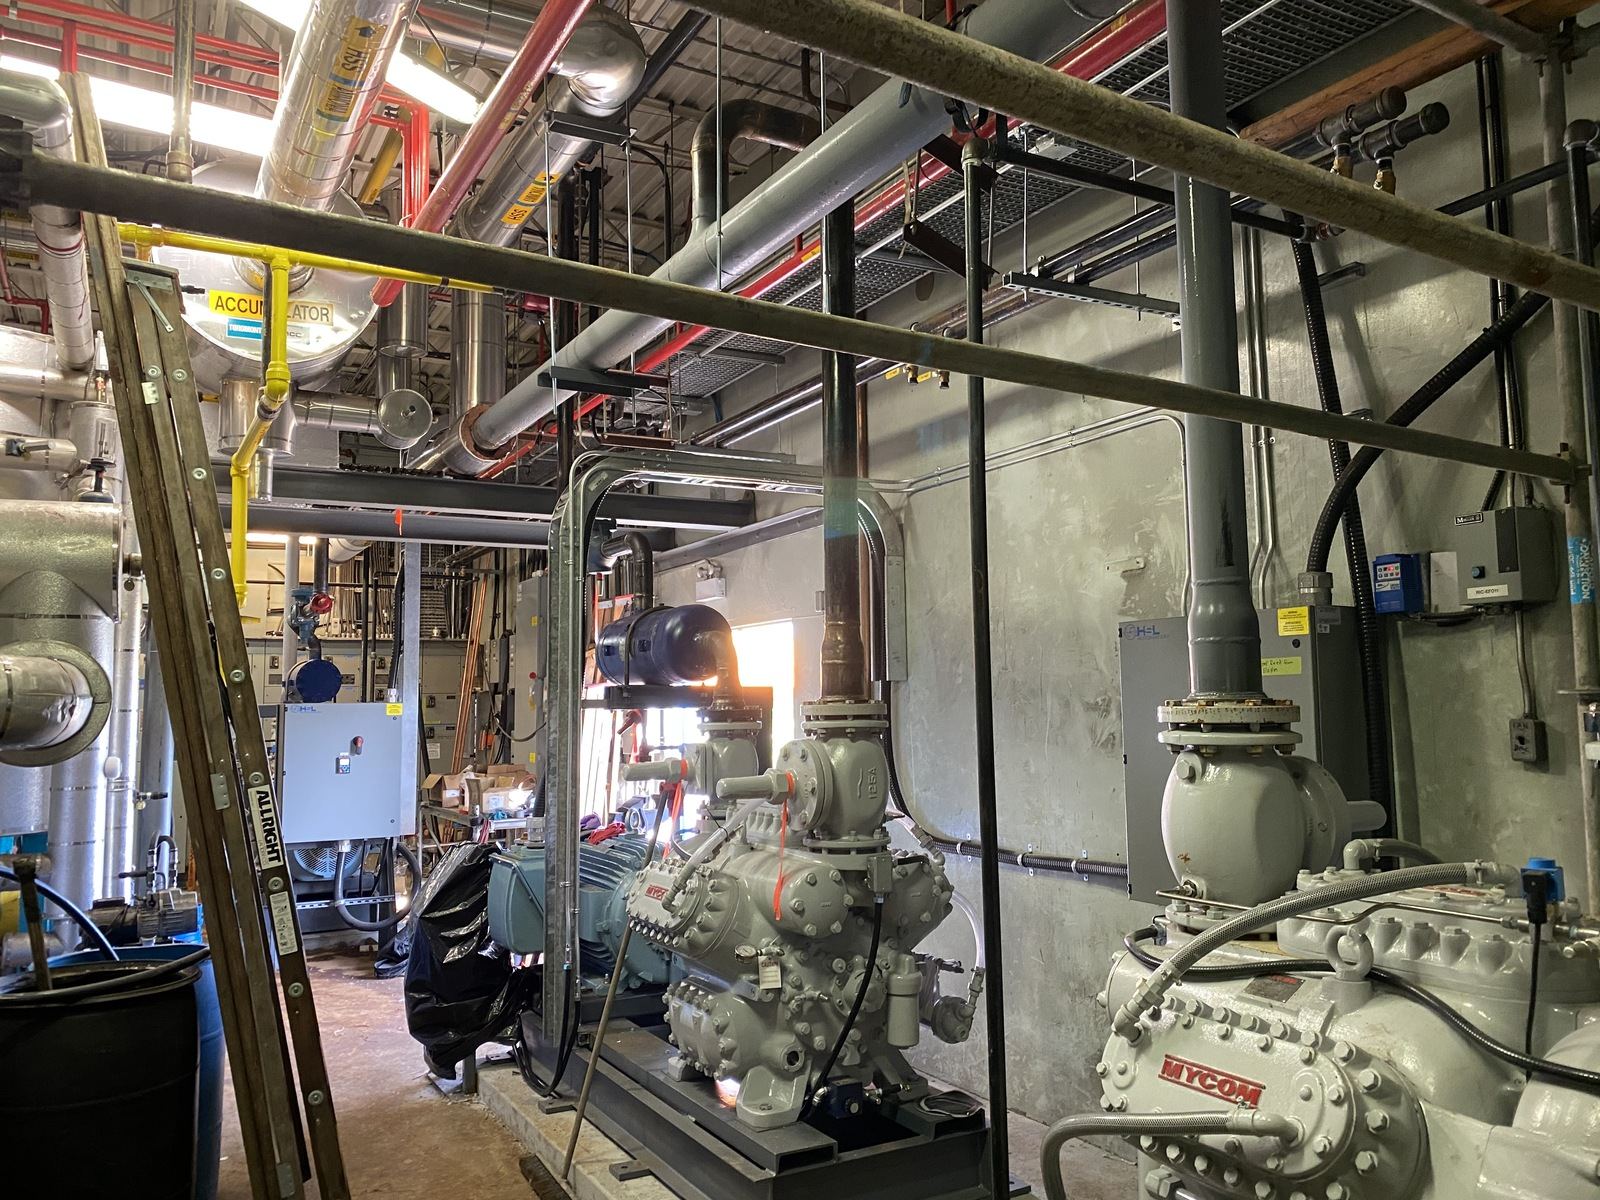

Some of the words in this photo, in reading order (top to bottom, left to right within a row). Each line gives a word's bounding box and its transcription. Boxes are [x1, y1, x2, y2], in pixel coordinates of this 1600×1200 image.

[341, 47, 368, 73] HSS
[215, 295, 330, 322] ACCUATOR
[256, 790, 281, 863] ALLRIGHT
[1161, 1059, 1262, 1106] MYCOM
